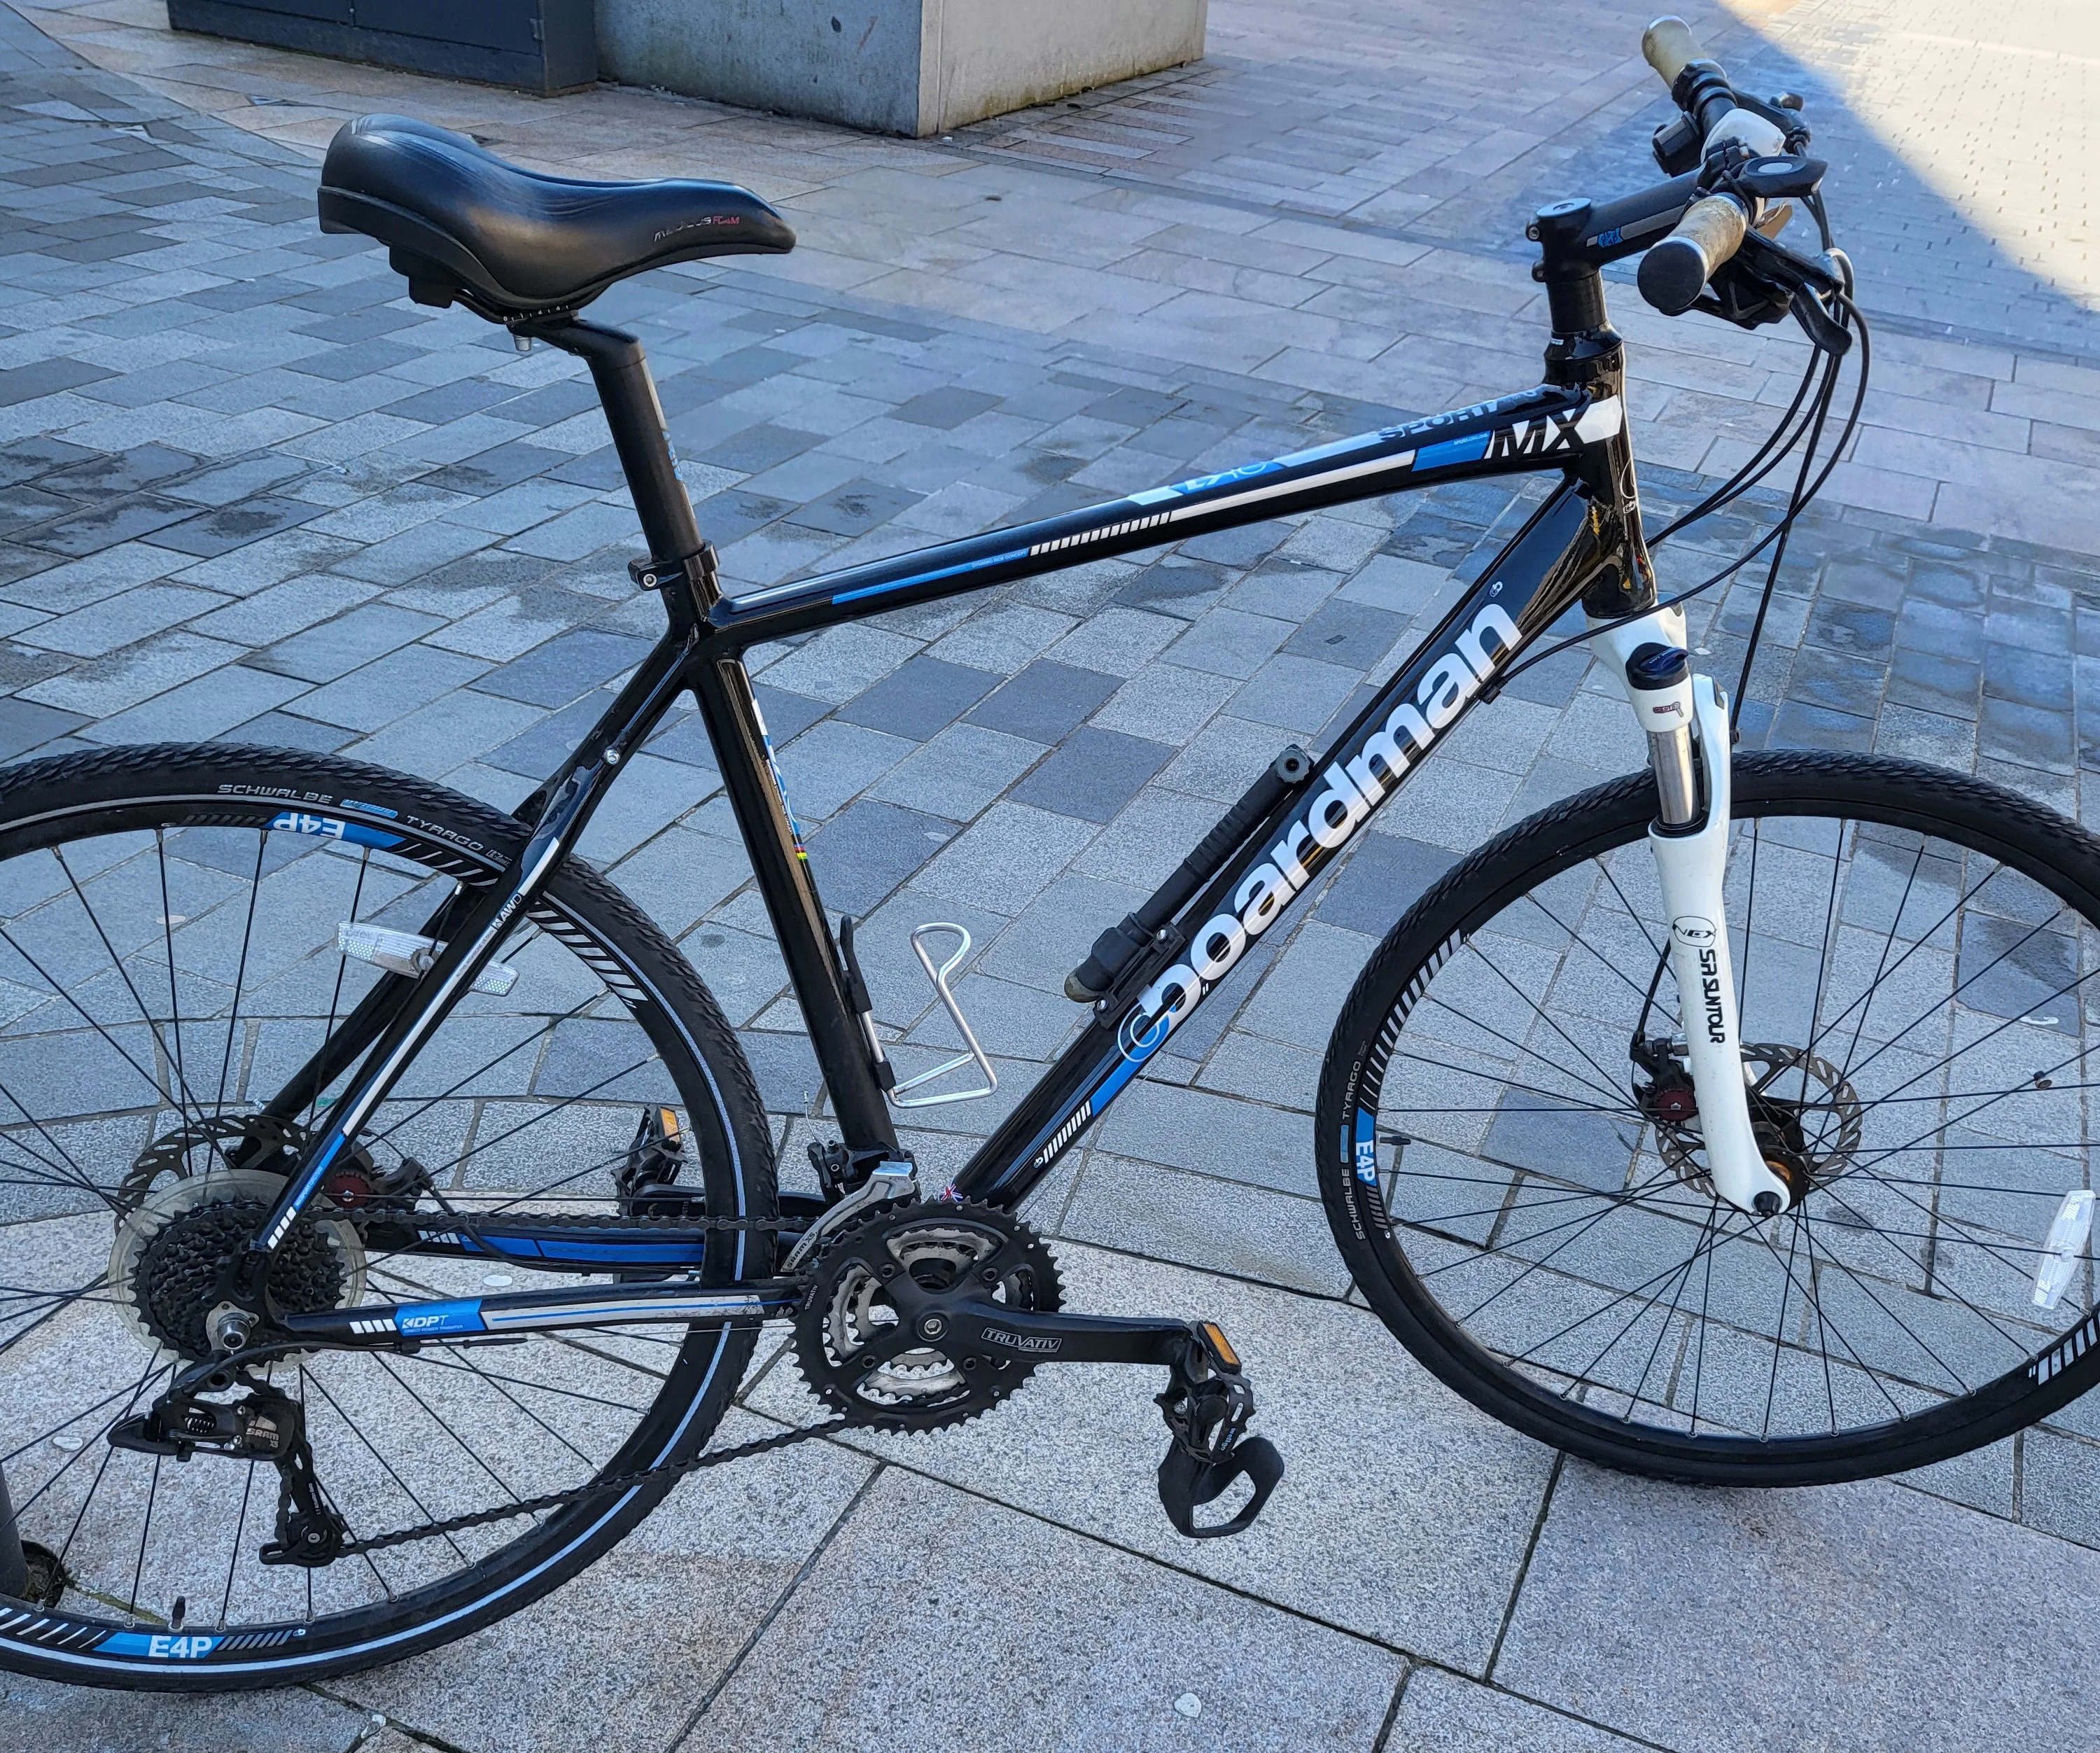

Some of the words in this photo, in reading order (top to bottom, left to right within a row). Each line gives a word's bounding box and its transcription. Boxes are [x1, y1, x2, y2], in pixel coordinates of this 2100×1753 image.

[1378, 399, 1499, 442] SPORT
[1484, 406, 1588, 461] MX
[217, 784, 334, 804] SCHWALBE
[273, 811, 346, 839] E4P
[1135, 603, 1523, 1025] boardman
[406, 815, 484, 851] TYRAGO
[500, 893, 522, 922] AWD
[1672, 923, 1717, 939] NEX
[1699, 949, 1717, 976] SR
[1702, 978, 1726, 1044] SUNTOUR
[1343, 1061, 1362, 1120] TYRAGO
[1356, 1139, 1376, 1184] E4P
[1341, 1167, 1366, 1241] SCHWALBE
[787, 1242, 807, 1268] SRAM
[805, 1285, 818, 1311] TRUVATIV
[986, 1329, 1059, 1348] TRUVATIV
[245, 1427, 279, 1441] SRAM
[148, 1635, 213, 1658] E4P
